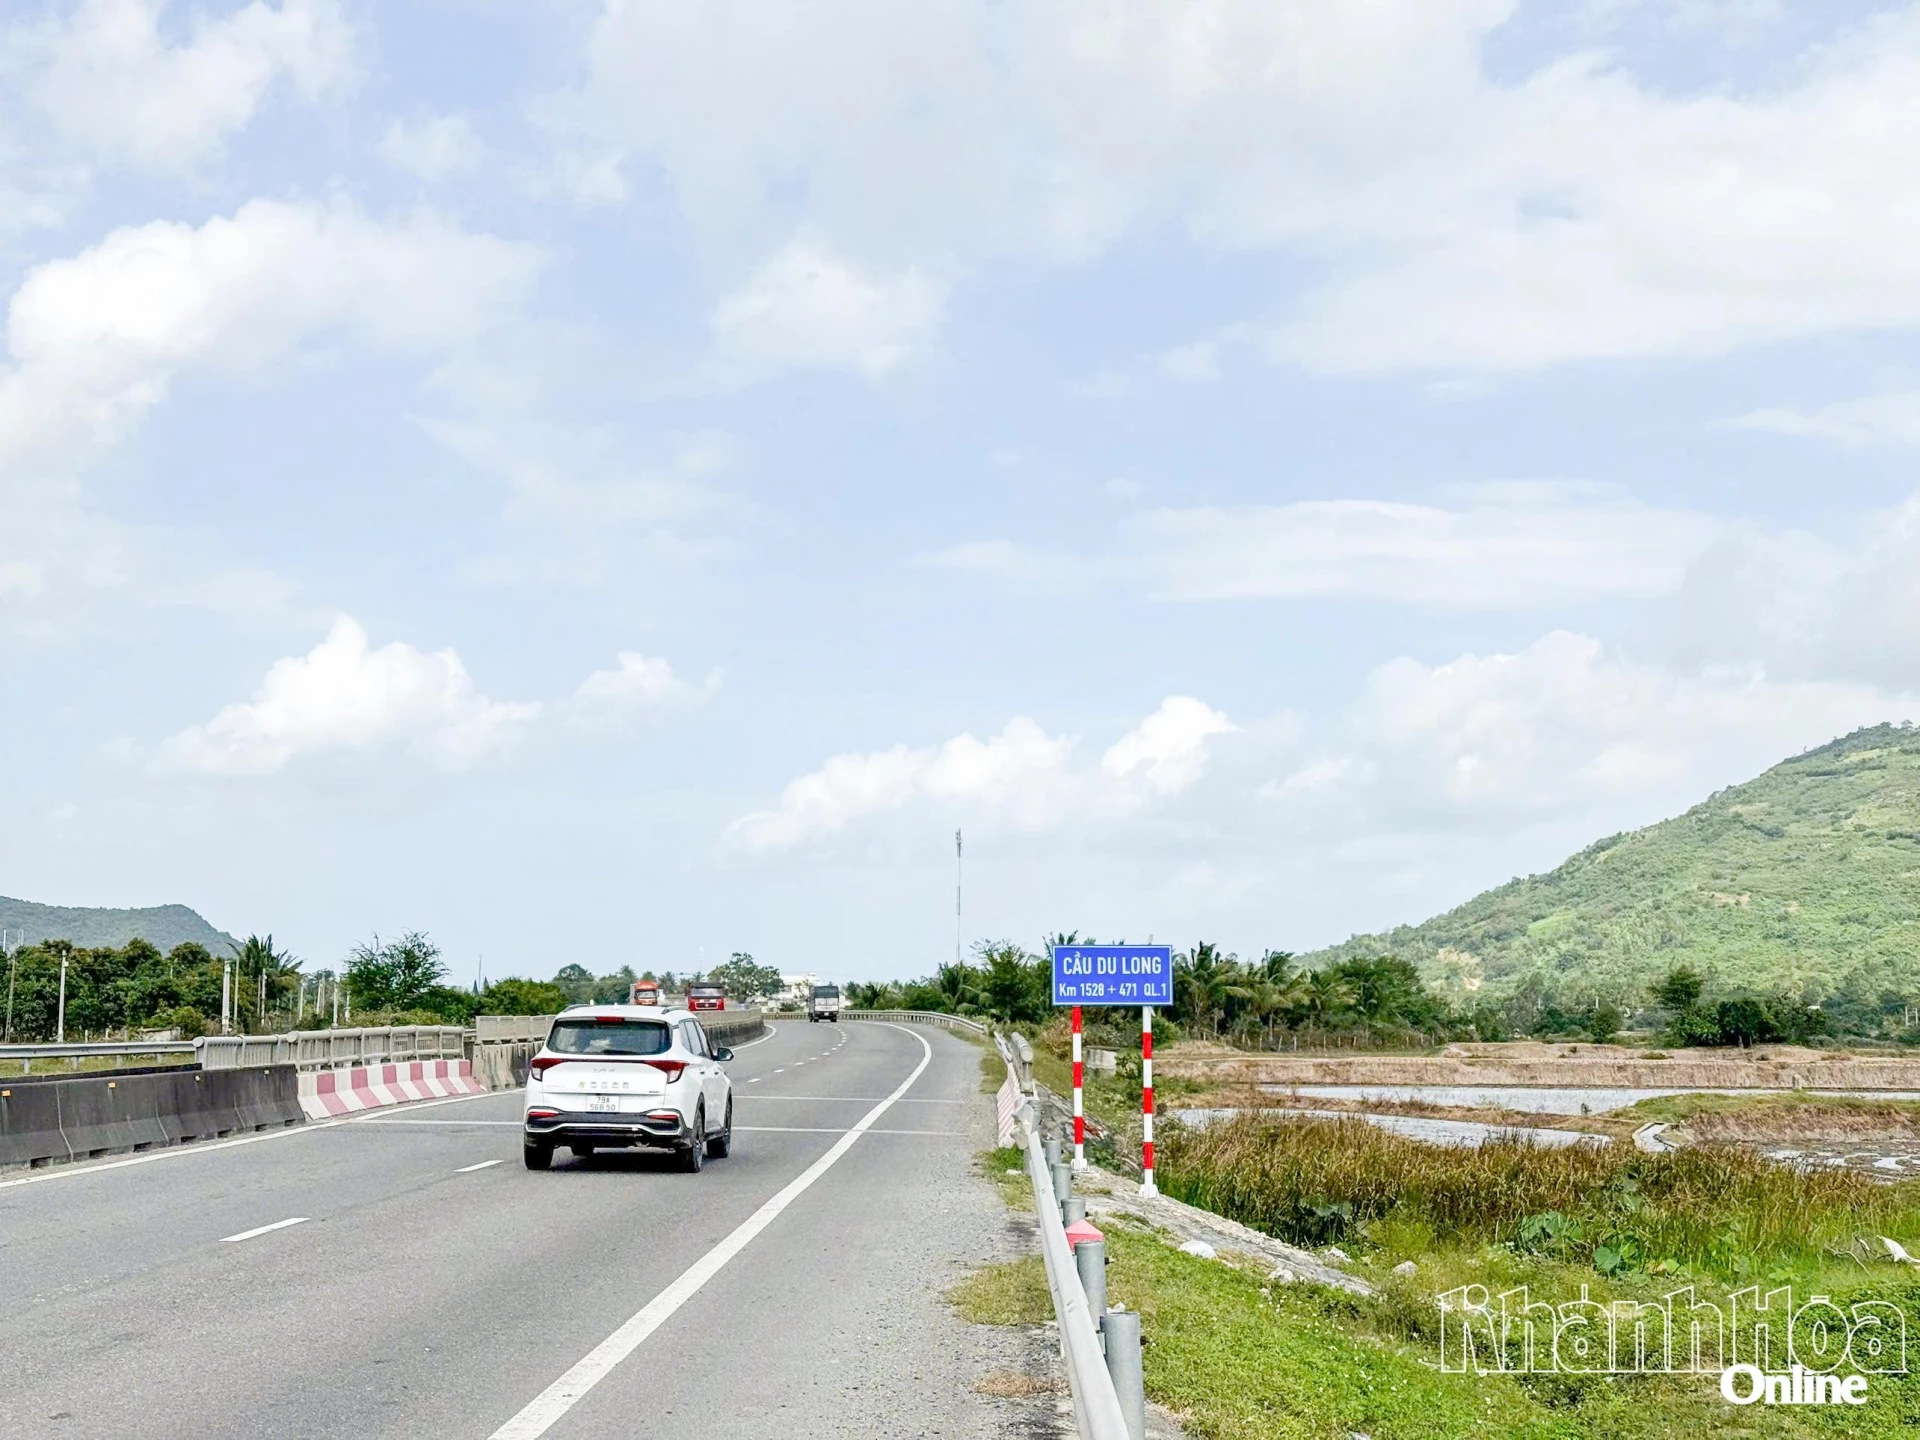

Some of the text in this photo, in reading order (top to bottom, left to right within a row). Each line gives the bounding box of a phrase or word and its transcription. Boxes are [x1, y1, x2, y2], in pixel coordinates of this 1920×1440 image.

[1063, 951, 1162, 975] CẦU DU LONG
[1059, 983, 1077, 997] Km
[1080, 983, 1105, 997] 1528
[1119, 983, 1137, 997] 471
[1143, 983, 1167, 997] QL.1
